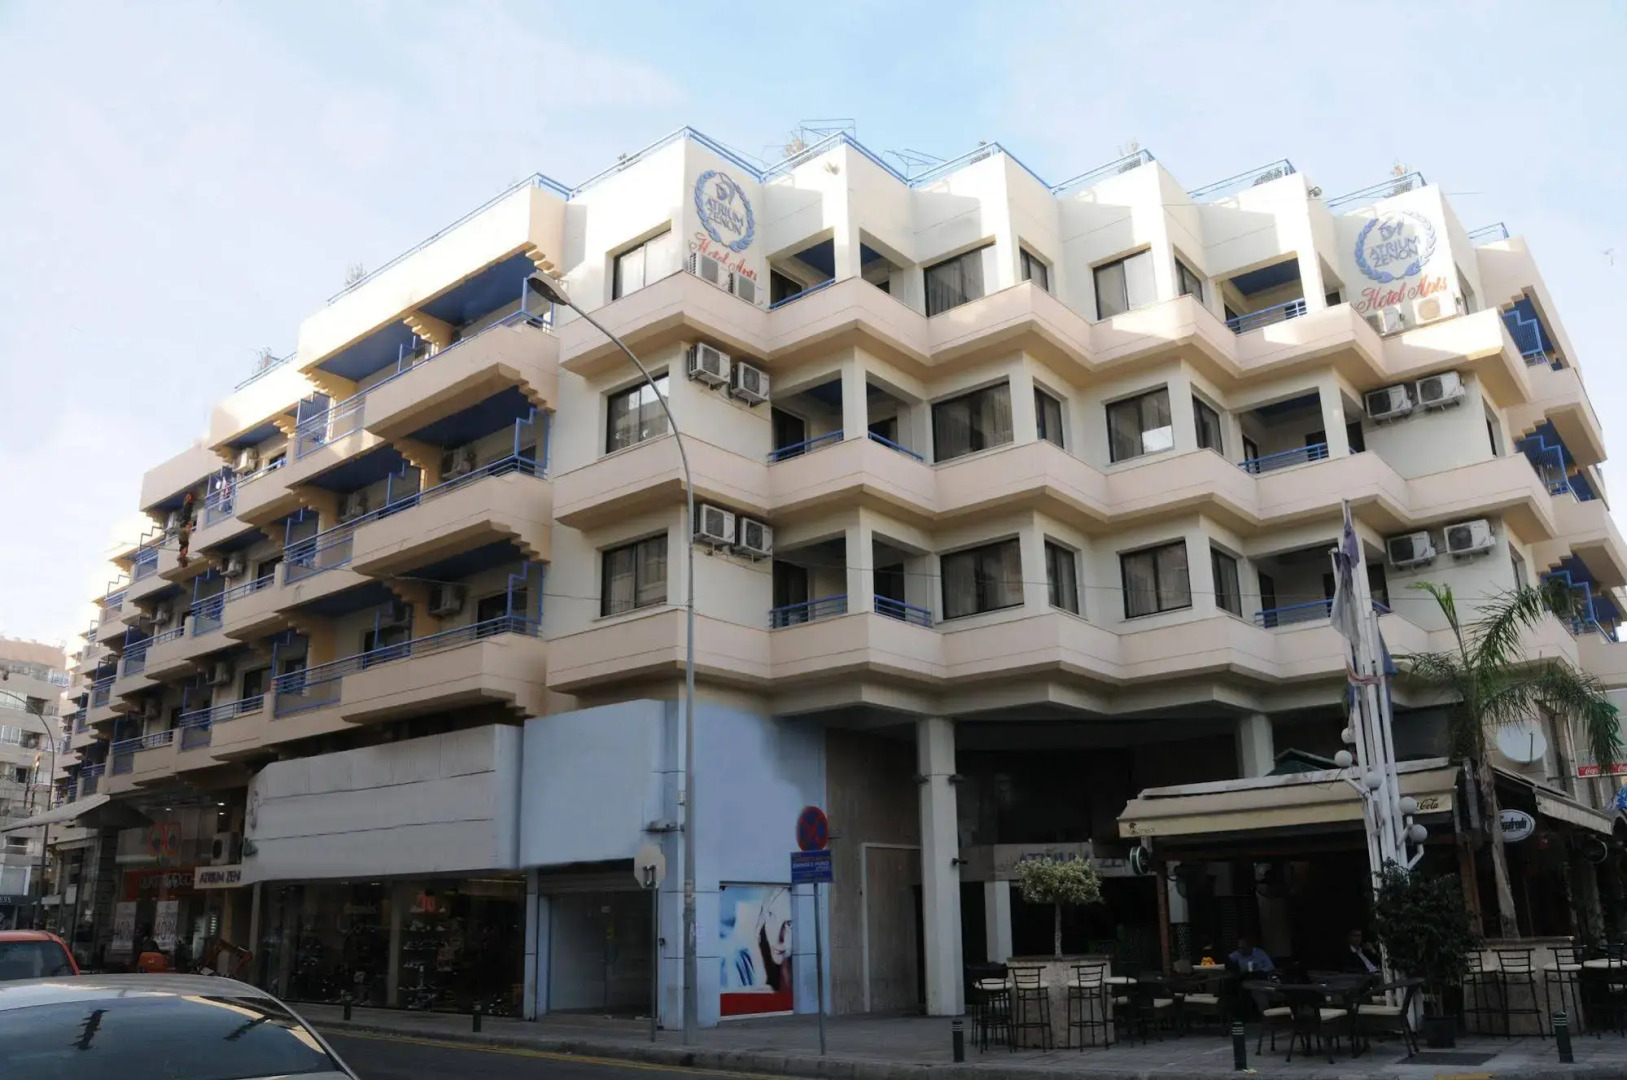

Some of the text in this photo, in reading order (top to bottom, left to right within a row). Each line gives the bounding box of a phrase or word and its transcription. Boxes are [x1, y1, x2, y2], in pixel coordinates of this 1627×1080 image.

[706, 198, 744, 228] ATRIUM
[708, 216, 742, 236] ZENON
[688, 231, 730, 265] Hotel
[1369, 236, 1420, 258] ATRIUM
[1373, 247, 1419, 268] ZENON
[1355, 281, 1406, 313] Hotel
